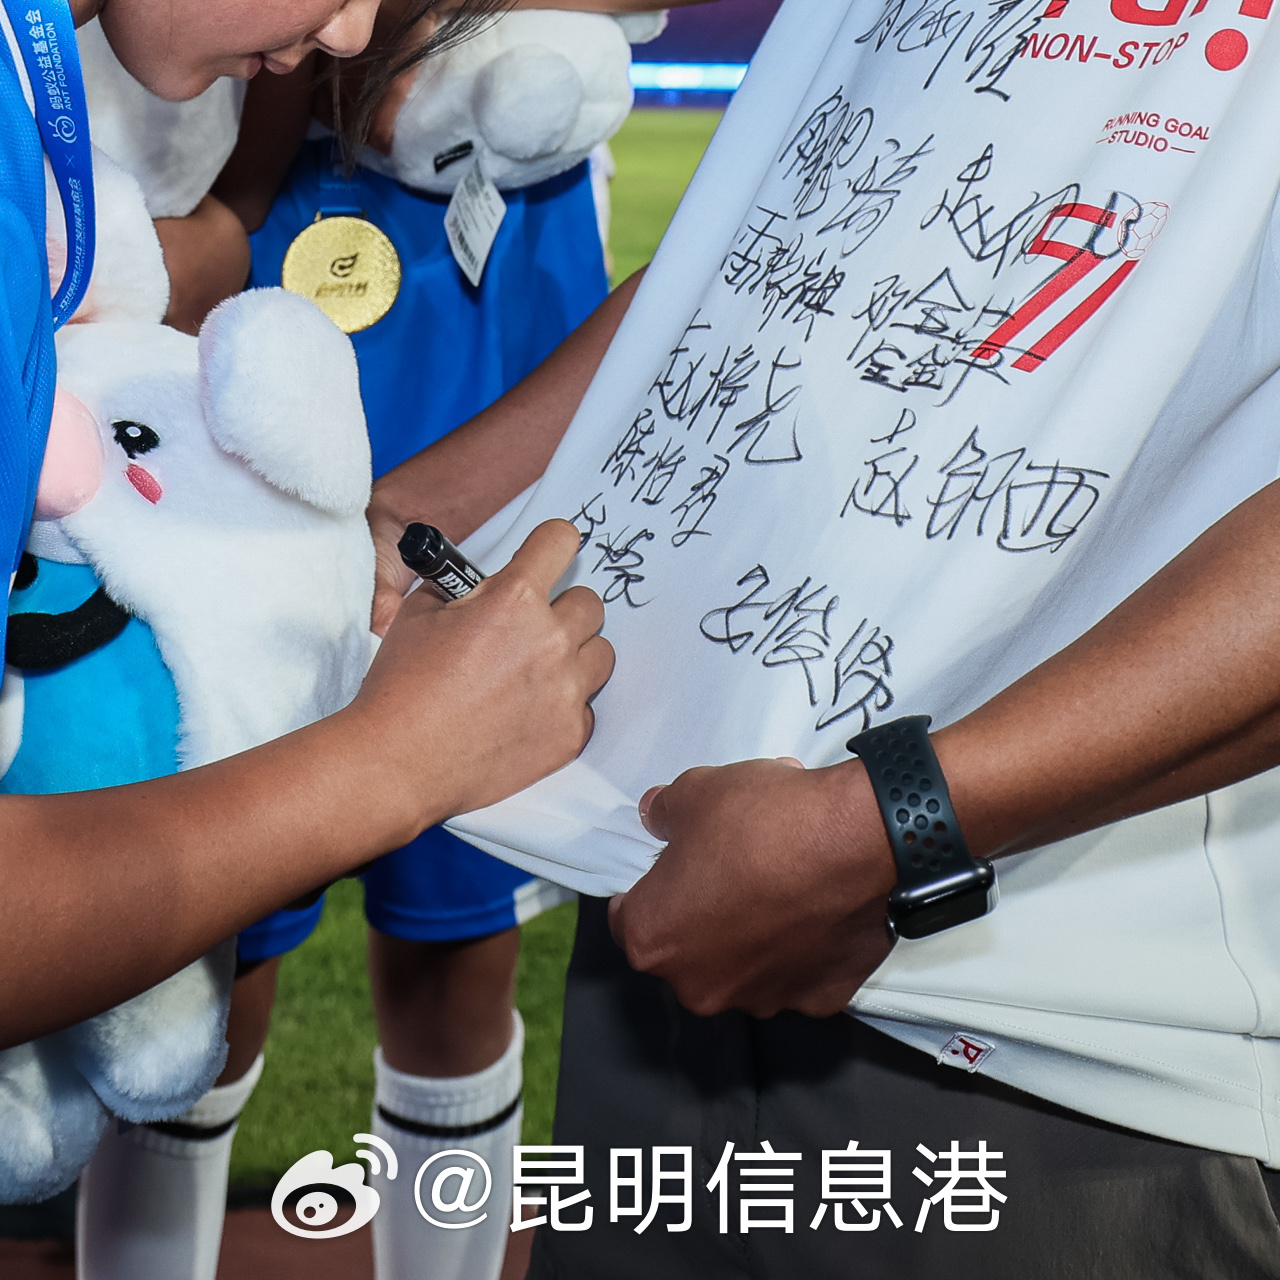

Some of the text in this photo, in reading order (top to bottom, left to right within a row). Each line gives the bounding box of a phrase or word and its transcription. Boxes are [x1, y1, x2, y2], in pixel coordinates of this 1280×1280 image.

[24, 9, 65, 110] 蚂蚁公益基金会
[45, 22, 73, 112] ANT FOUNDATION
[1019, 31, 1190, 69] NON-STOP
[1102, 111, 1210, 140] RUNNING GOAL
[1107, 130, 1169, 153] STUDIO
